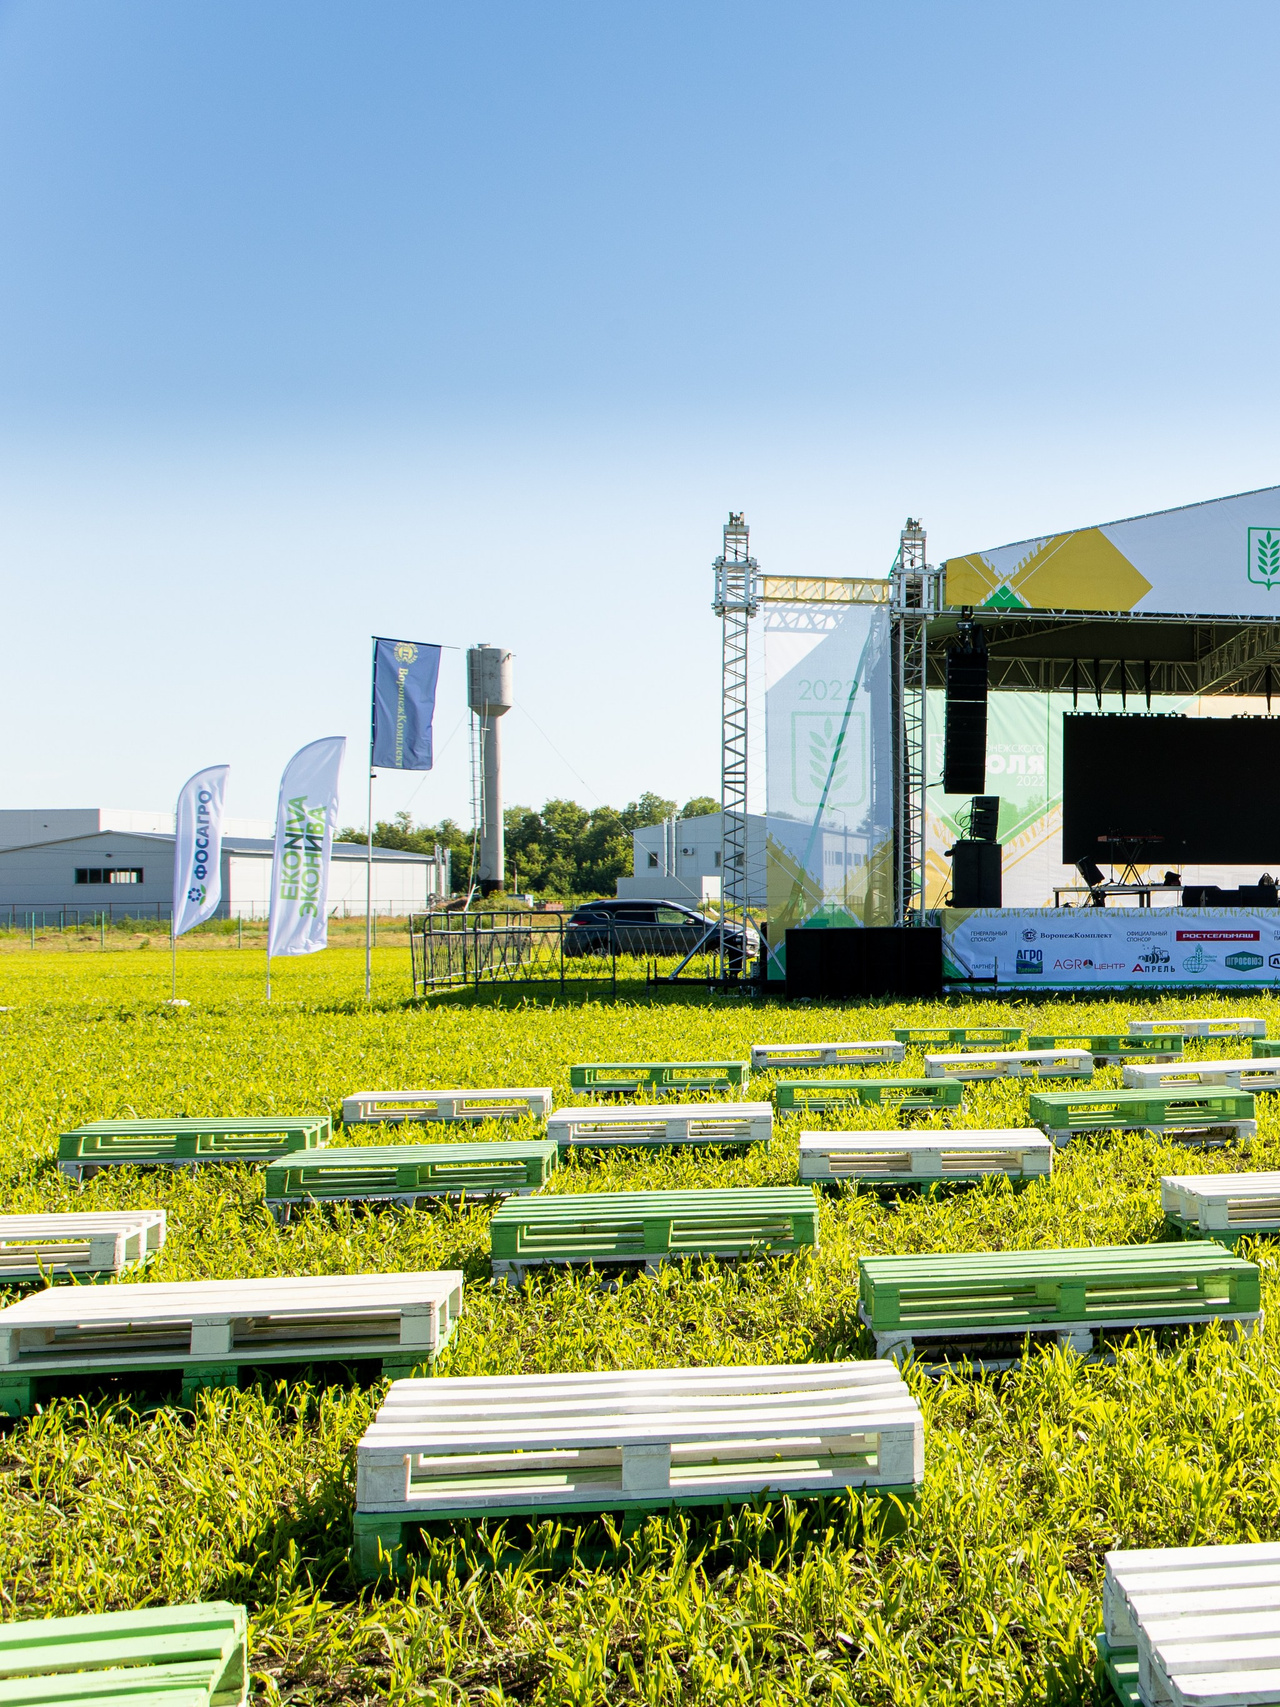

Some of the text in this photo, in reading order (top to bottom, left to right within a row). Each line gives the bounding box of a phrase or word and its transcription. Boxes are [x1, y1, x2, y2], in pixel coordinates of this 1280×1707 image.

[798, 679, 859, 701] 2022
[986, 753, 1045, 775] ОЛЯ
[1016, 775, 1046, 787] 2022
[194, 789, 213, 880] ФОСАГРО
[280, 795, 309, 901] EKONIVA
[299, 805, 328, 919] ЭКОНИВА
[1040, 932, 1112, 940] ВоронежКомплект
[1016, 949, 1043, 961] АГРО
